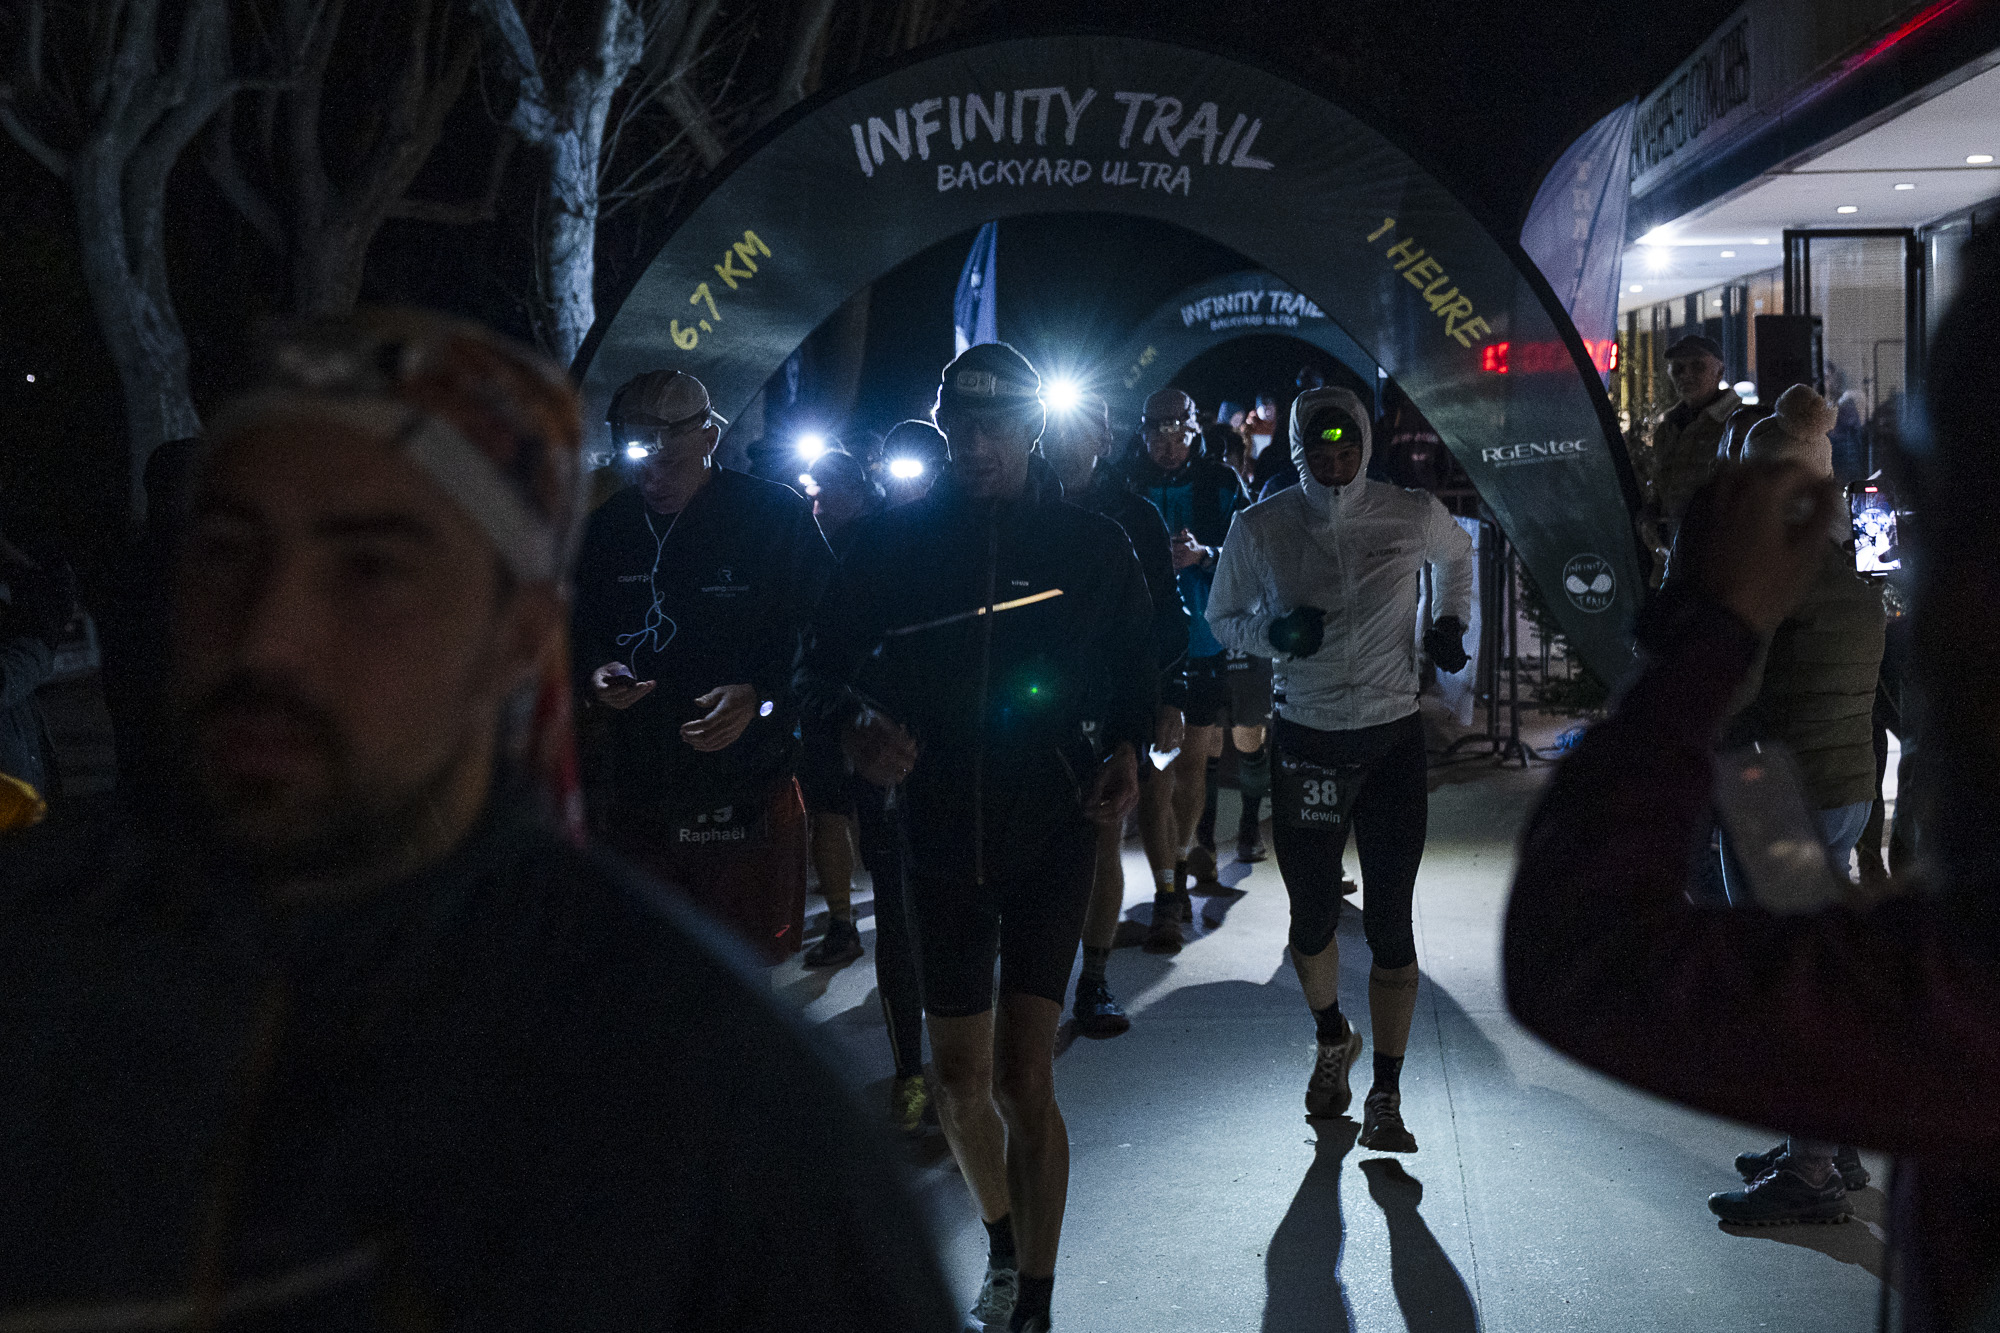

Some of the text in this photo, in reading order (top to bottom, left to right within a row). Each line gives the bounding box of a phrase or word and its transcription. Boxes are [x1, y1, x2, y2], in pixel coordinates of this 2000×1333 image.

[851, 86, 1275, 178] INFINITY TRAIL
[937, 157, 1191, 197] BACKYARD ULTRA
[670, 230, 772, 351] 6,7 KM
[1367, 217, 1492, 348] 1 HEURE
[1180, 290, 1265, 328] INFINITY
[1302, 780, 1338, 807] 38
[679, 826, 746, 845] Raphaël
[1300, 808, 1341, 824] Kewin
